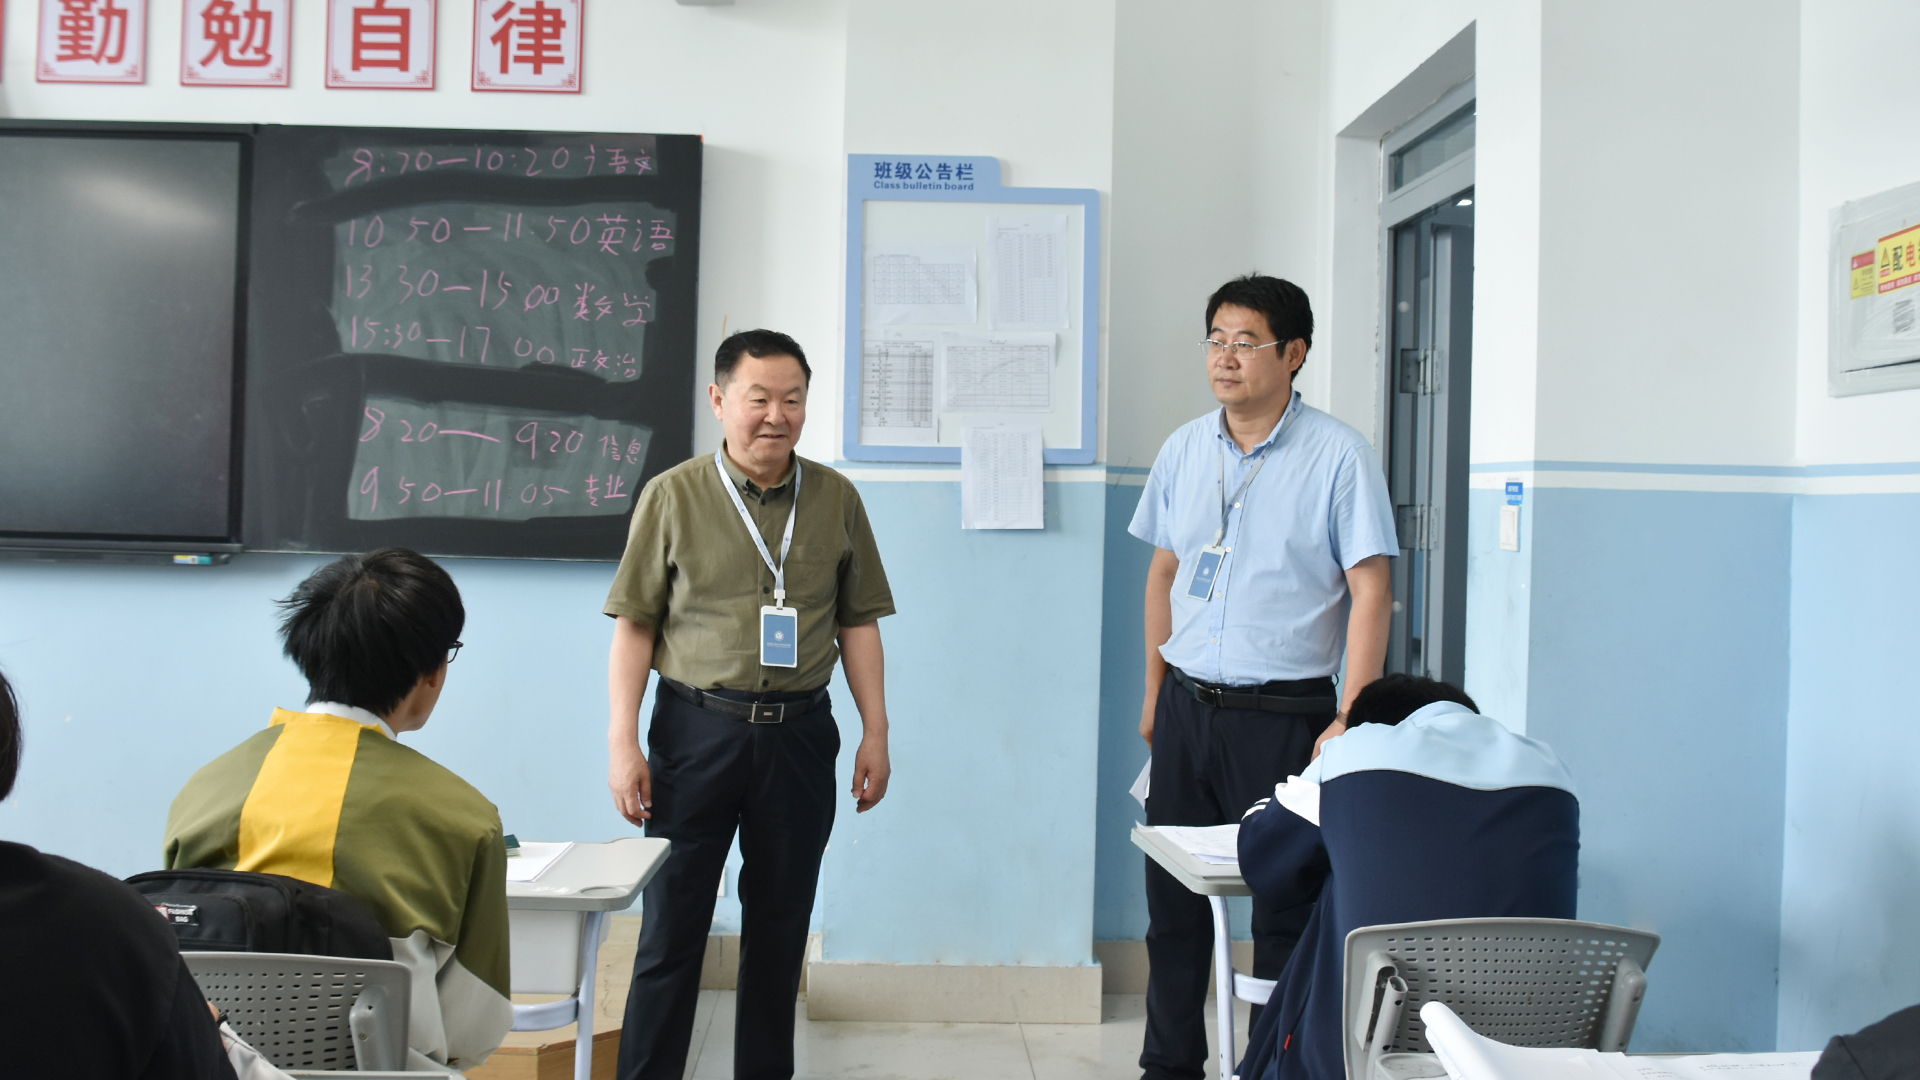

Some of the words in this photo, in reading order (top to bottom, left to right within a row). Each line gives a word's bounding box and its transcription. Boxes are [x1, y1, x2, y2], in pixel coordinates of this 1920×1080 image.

[56, 0, 128, 64] 勤
[199, 0, 273, 67] 勉
[351, 0, 411, 72] 自
[490, 0, 566, 75] 律
[874, 161, 974, 181] 班级公告栏
[874, 181, 901, 190] Class
[903, 182, 942, 190] bulletin
[944, 183, 974, 191] board
[1892, 238, 1920, 273] 配电
